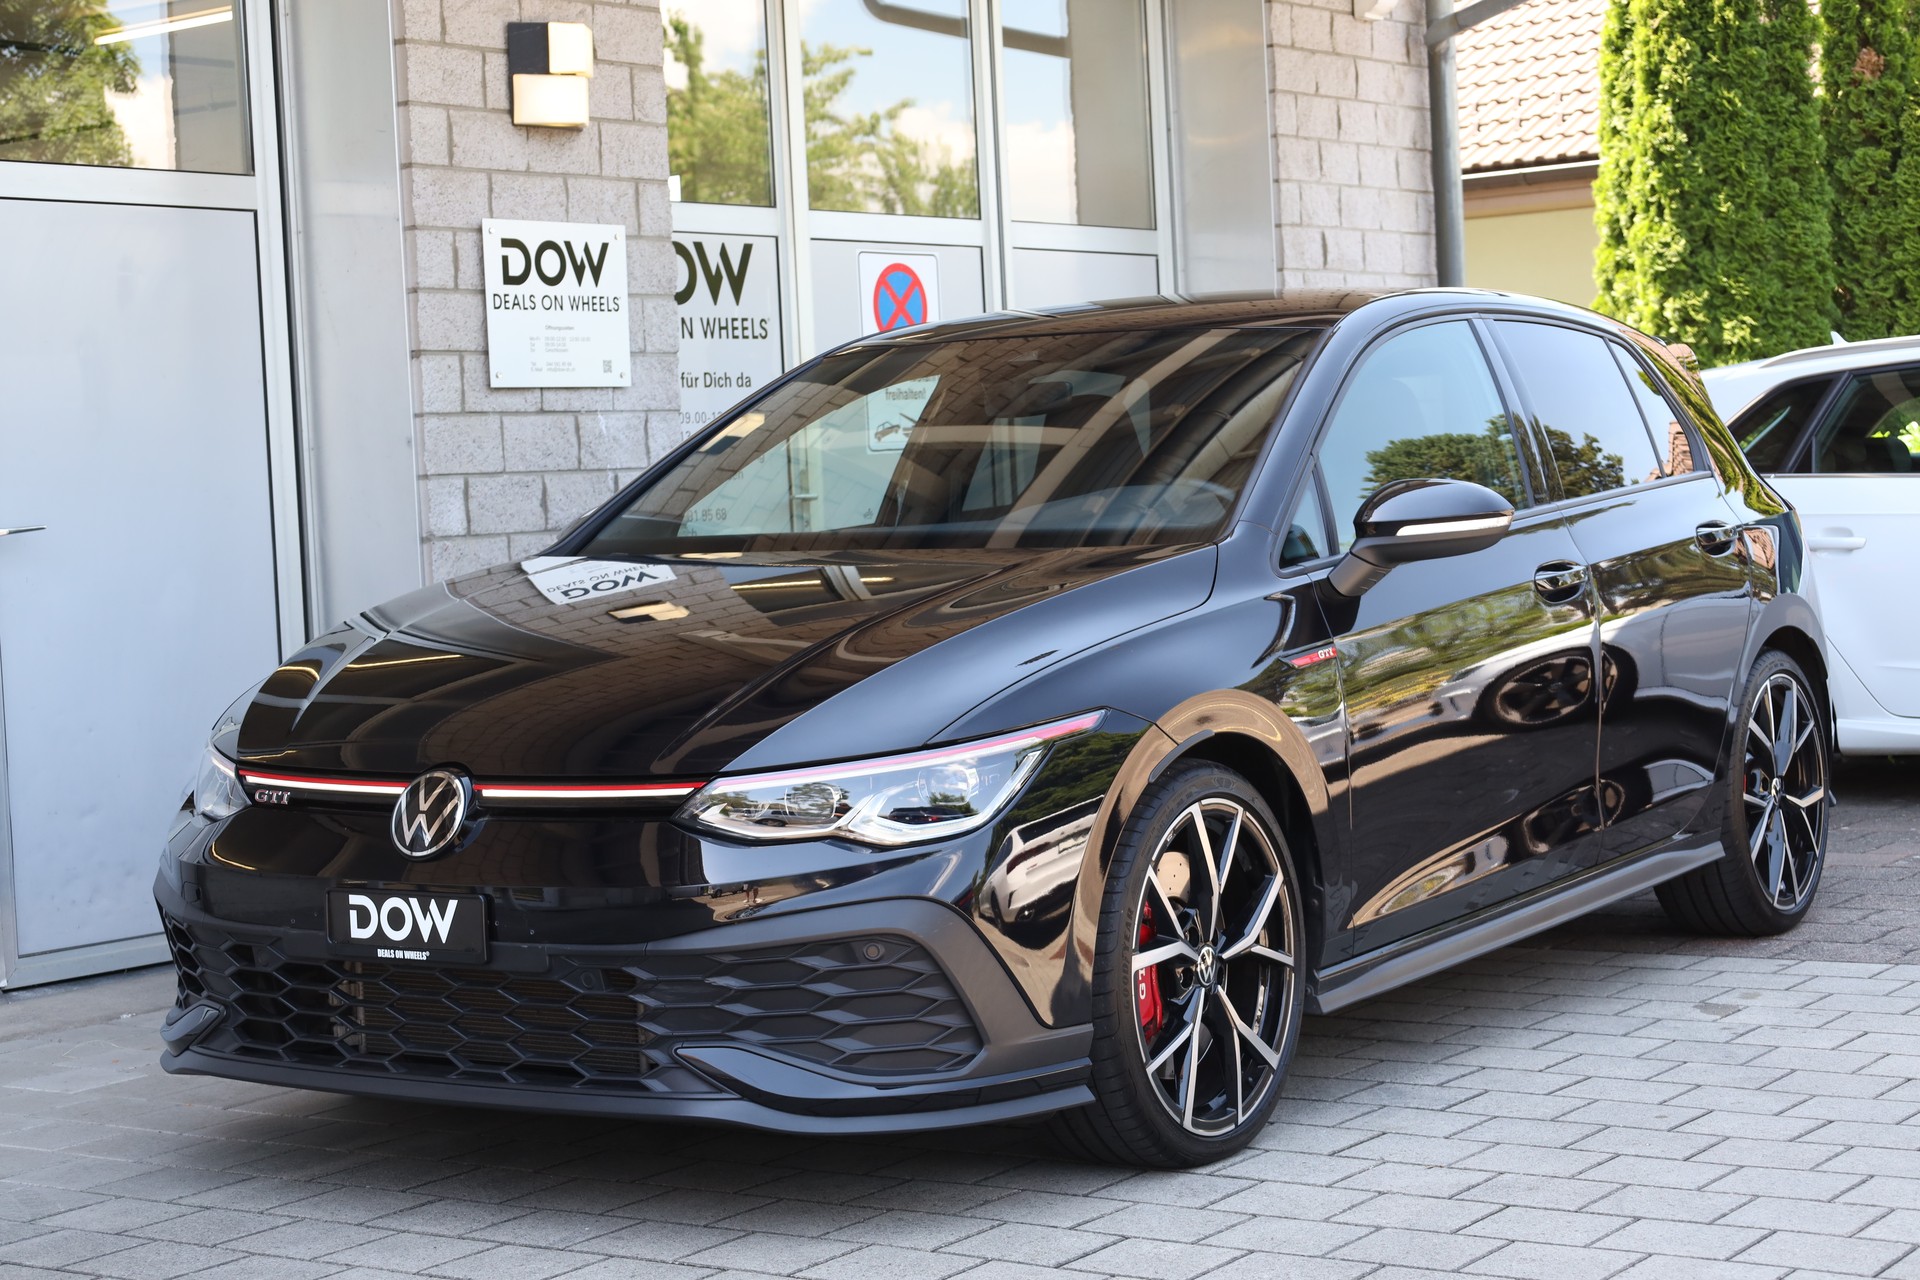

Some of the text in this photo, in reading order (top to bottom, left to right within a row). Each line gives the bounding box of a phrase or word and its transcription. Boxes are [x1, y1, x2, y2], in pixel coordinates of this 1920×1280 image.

[500, 237, 610, 288] DOW
[672, 240, 754, 306] OW
[493, 293, 620, 312] DEALS ON WHEELS
[681, 316, 768, 339] N WHEELS
[680, 371, 752, 388] für Dich da
[1317, 646, 1334, 659] GTI
[254, 788, 291, 805] GTI
[348, 893, 459, 945] DOW
[377, 948, 395, 959] DEALS
[395, 949, 404, 960] ON
